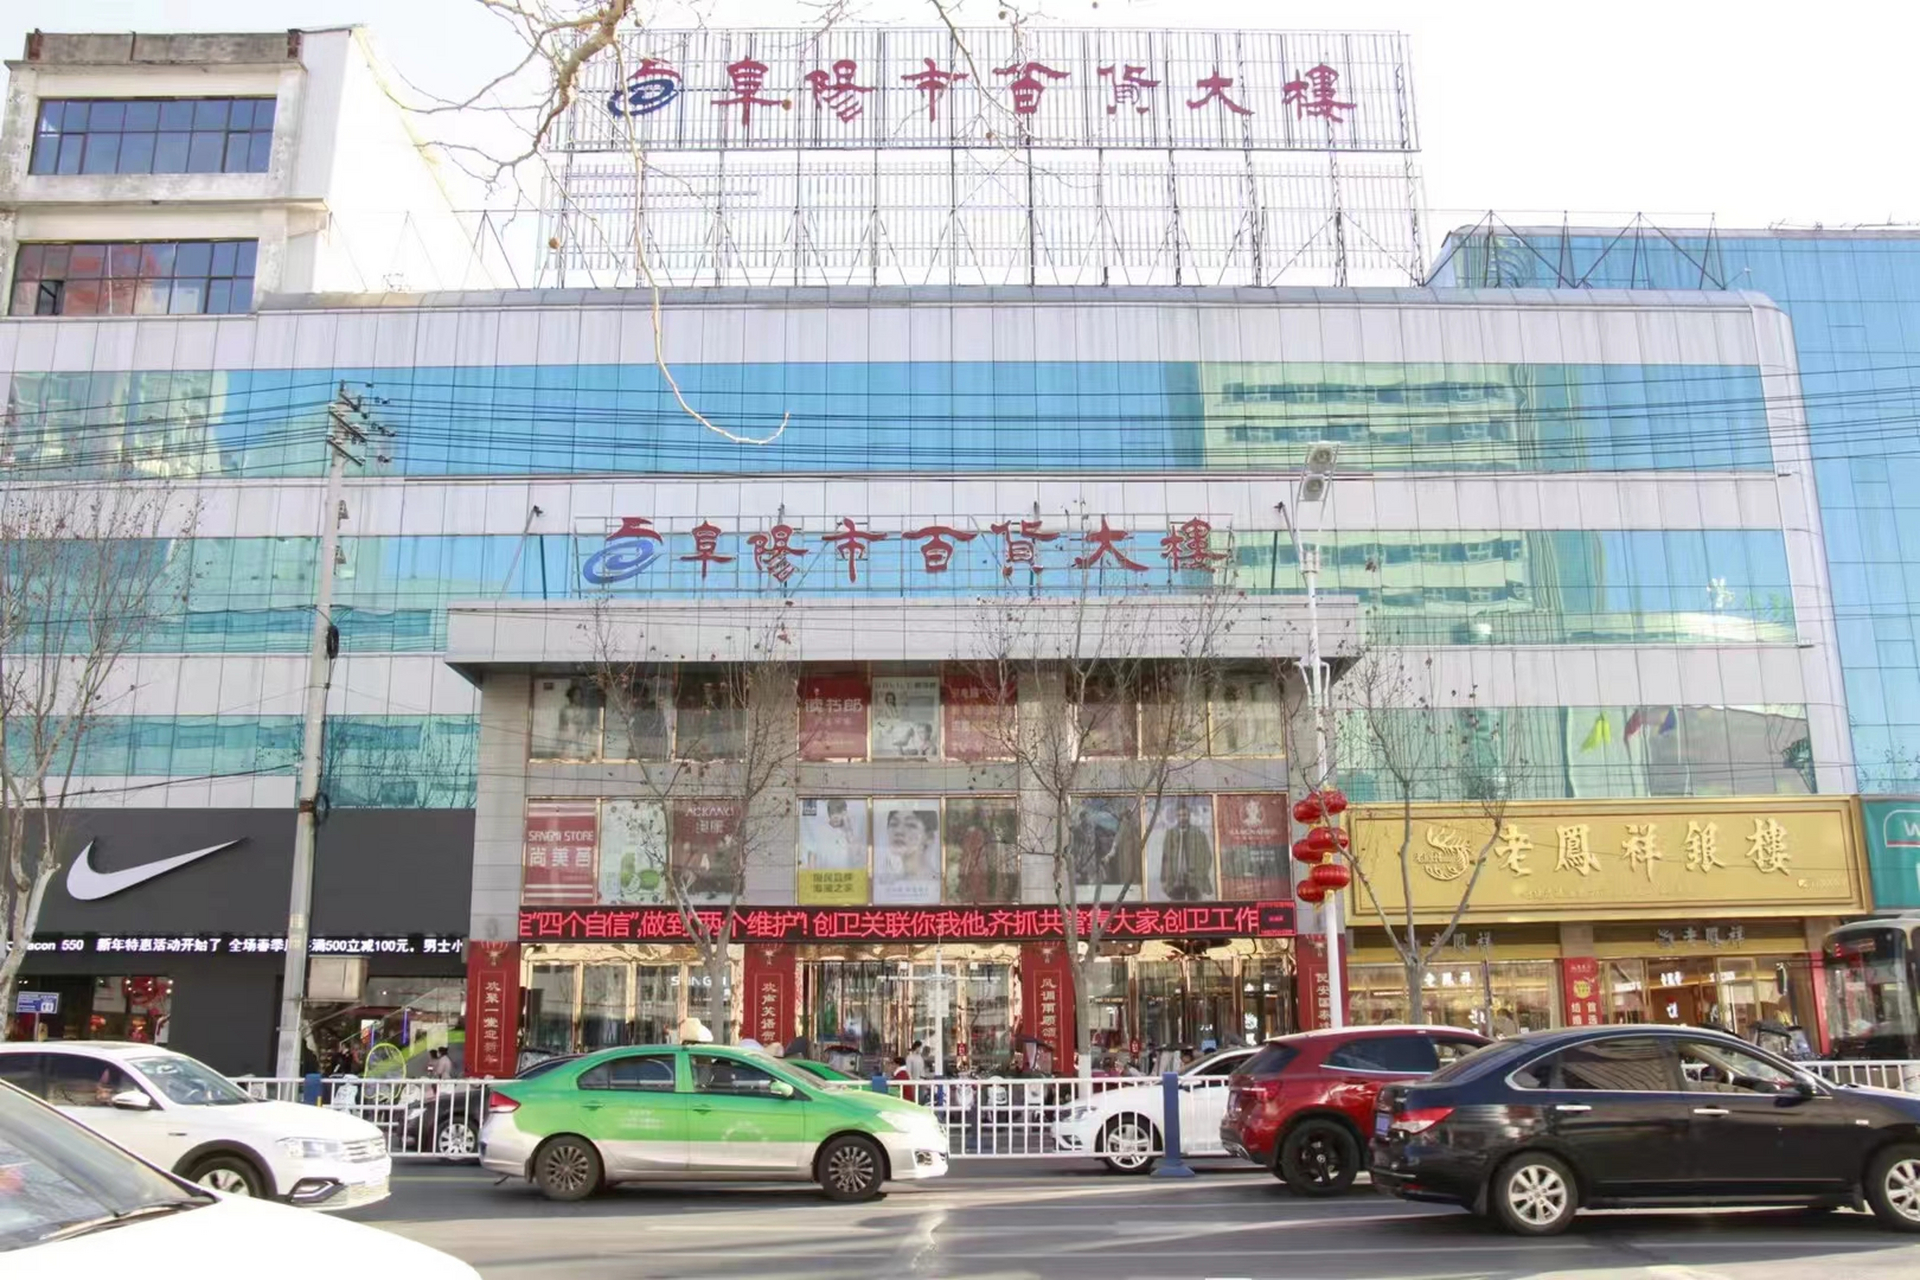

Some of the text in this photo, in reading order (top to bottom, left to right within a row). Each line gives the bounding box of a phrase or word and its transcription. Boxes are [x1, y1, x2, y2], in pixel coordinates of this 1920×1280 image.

[564, 830, 594, 842] STORE
[1494, 818, 1791, 882] 老鳳祥銀樓
[61, 939, 85, 951] 550
[671, 975, 727, 987] SNGI
[760, 982, 778, 1044] 欢声笑语贺
[1039, 978, 1058, 1046] 风调雨顺颂
